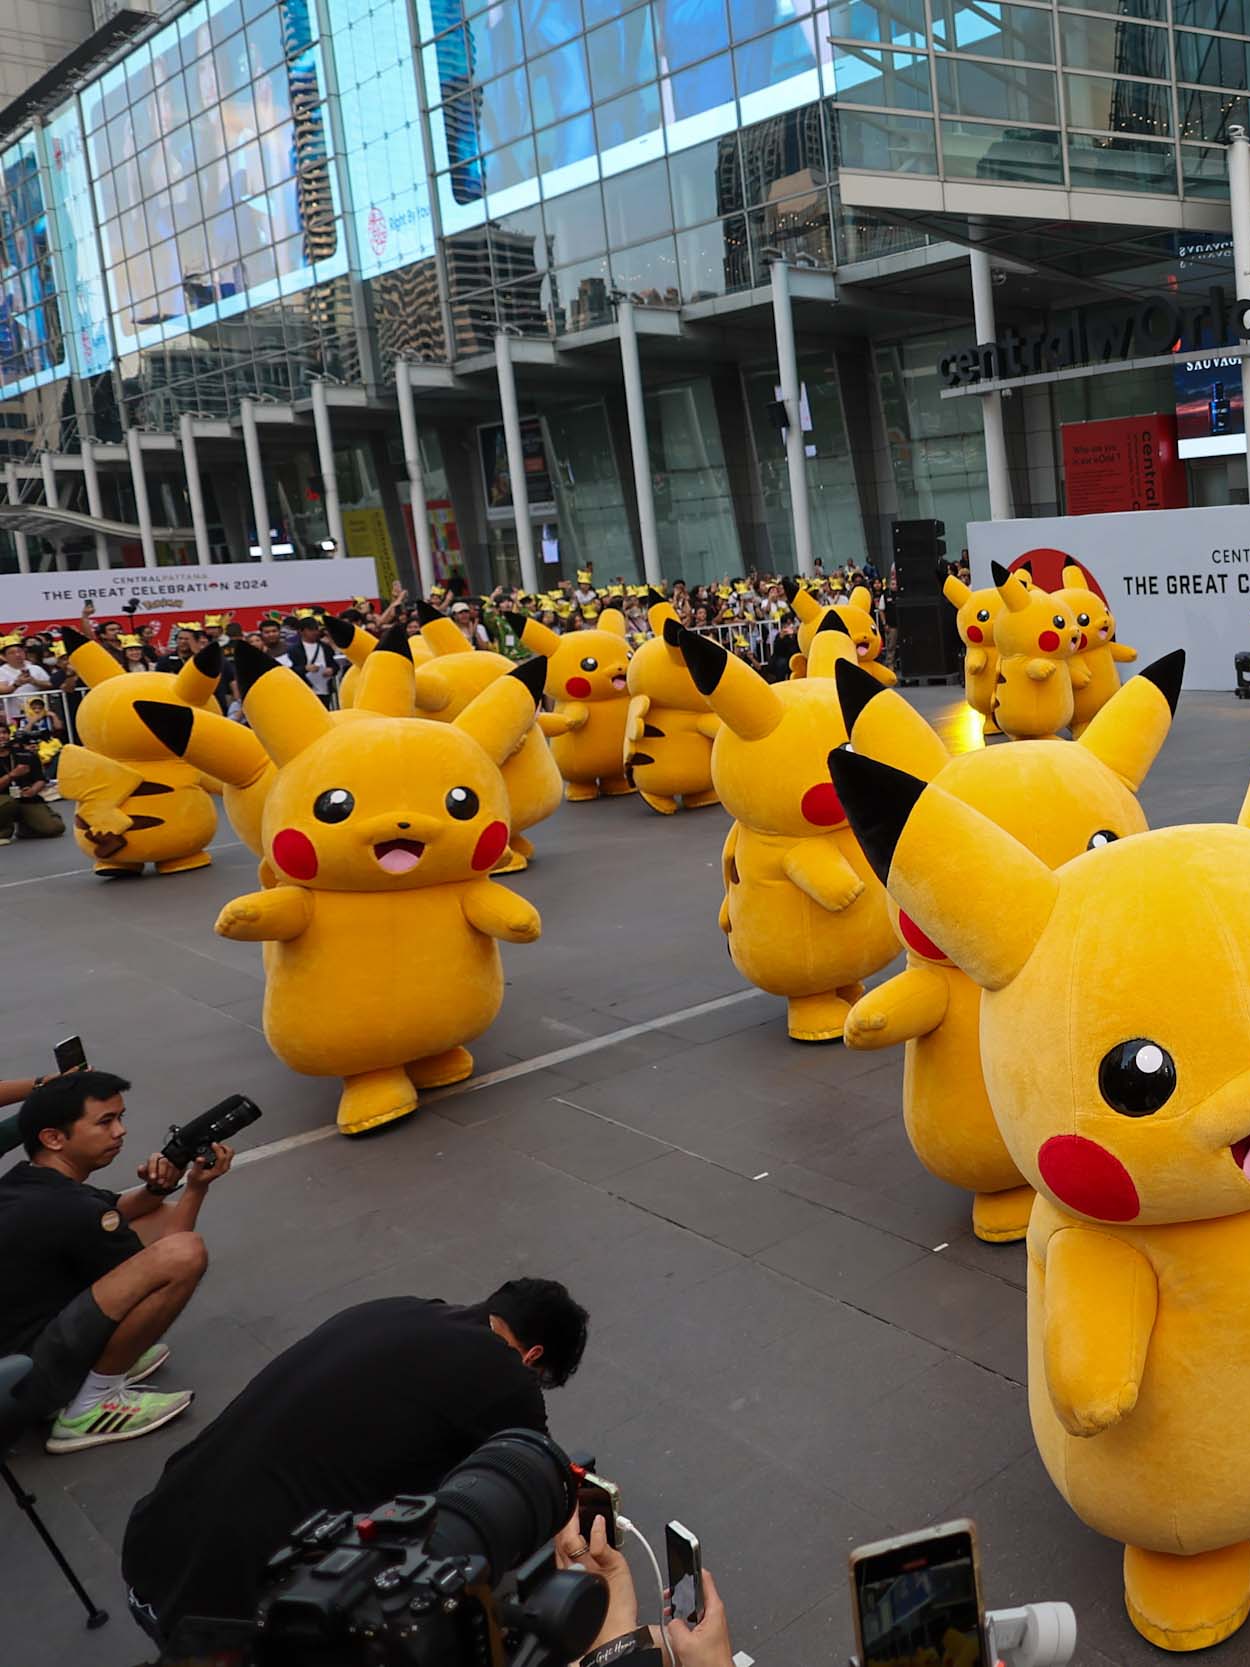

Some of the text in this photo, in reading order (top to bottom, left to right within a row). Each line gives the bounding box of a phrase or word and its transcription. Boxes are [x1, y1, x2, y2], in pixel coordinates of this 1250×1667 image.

[1142, 431, 1160, 507] central
[42, 589, 73, 602] THE
[77, 586, 126, 600] GREAT
[233, 579, 269, 591] 2024
[1123, 575, 1159, 596] THE
[1167, 573, 1229, 595] GREAT
